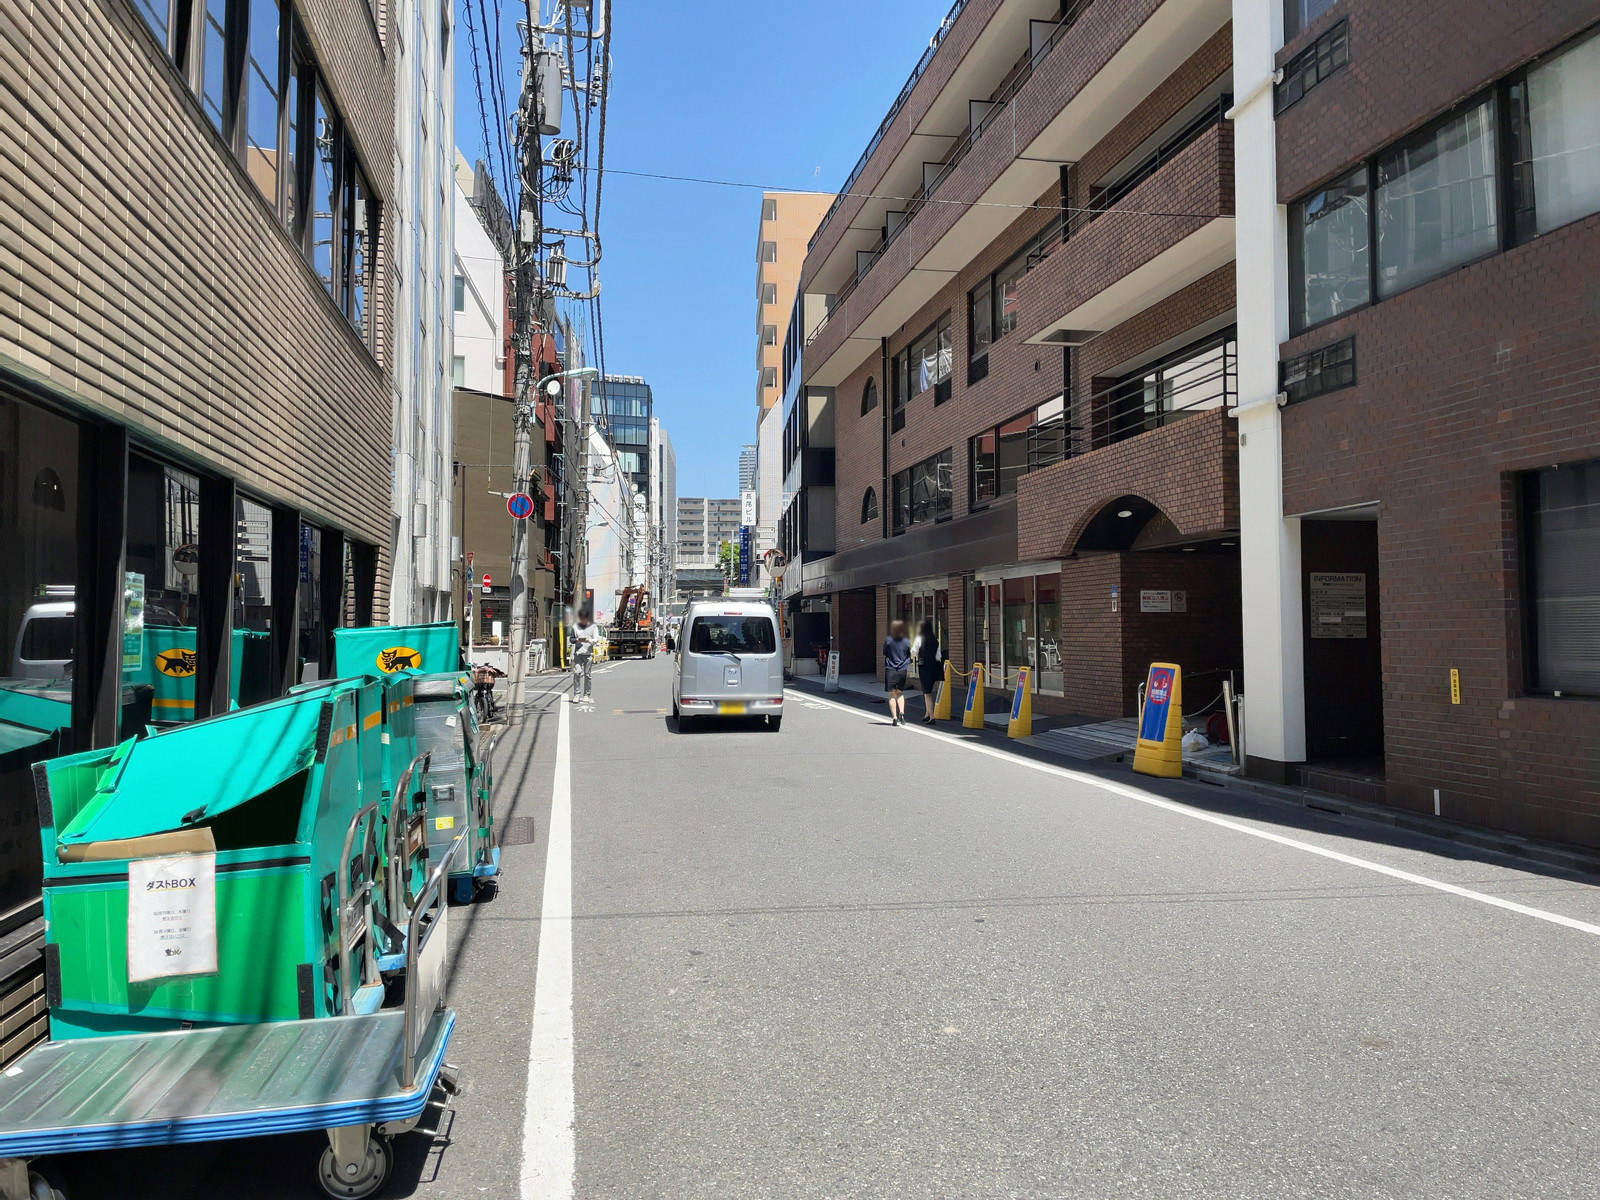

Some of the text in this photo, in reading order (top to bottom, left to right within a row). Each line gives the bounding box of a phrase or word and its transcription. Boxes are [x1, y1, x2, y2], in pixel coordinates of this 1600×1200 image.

[745, 493, 753, 523] 長尾ビル
[1313, 575, 1362, 583] INFORMATION
[146, 877, 197, 891] ダストBOX
